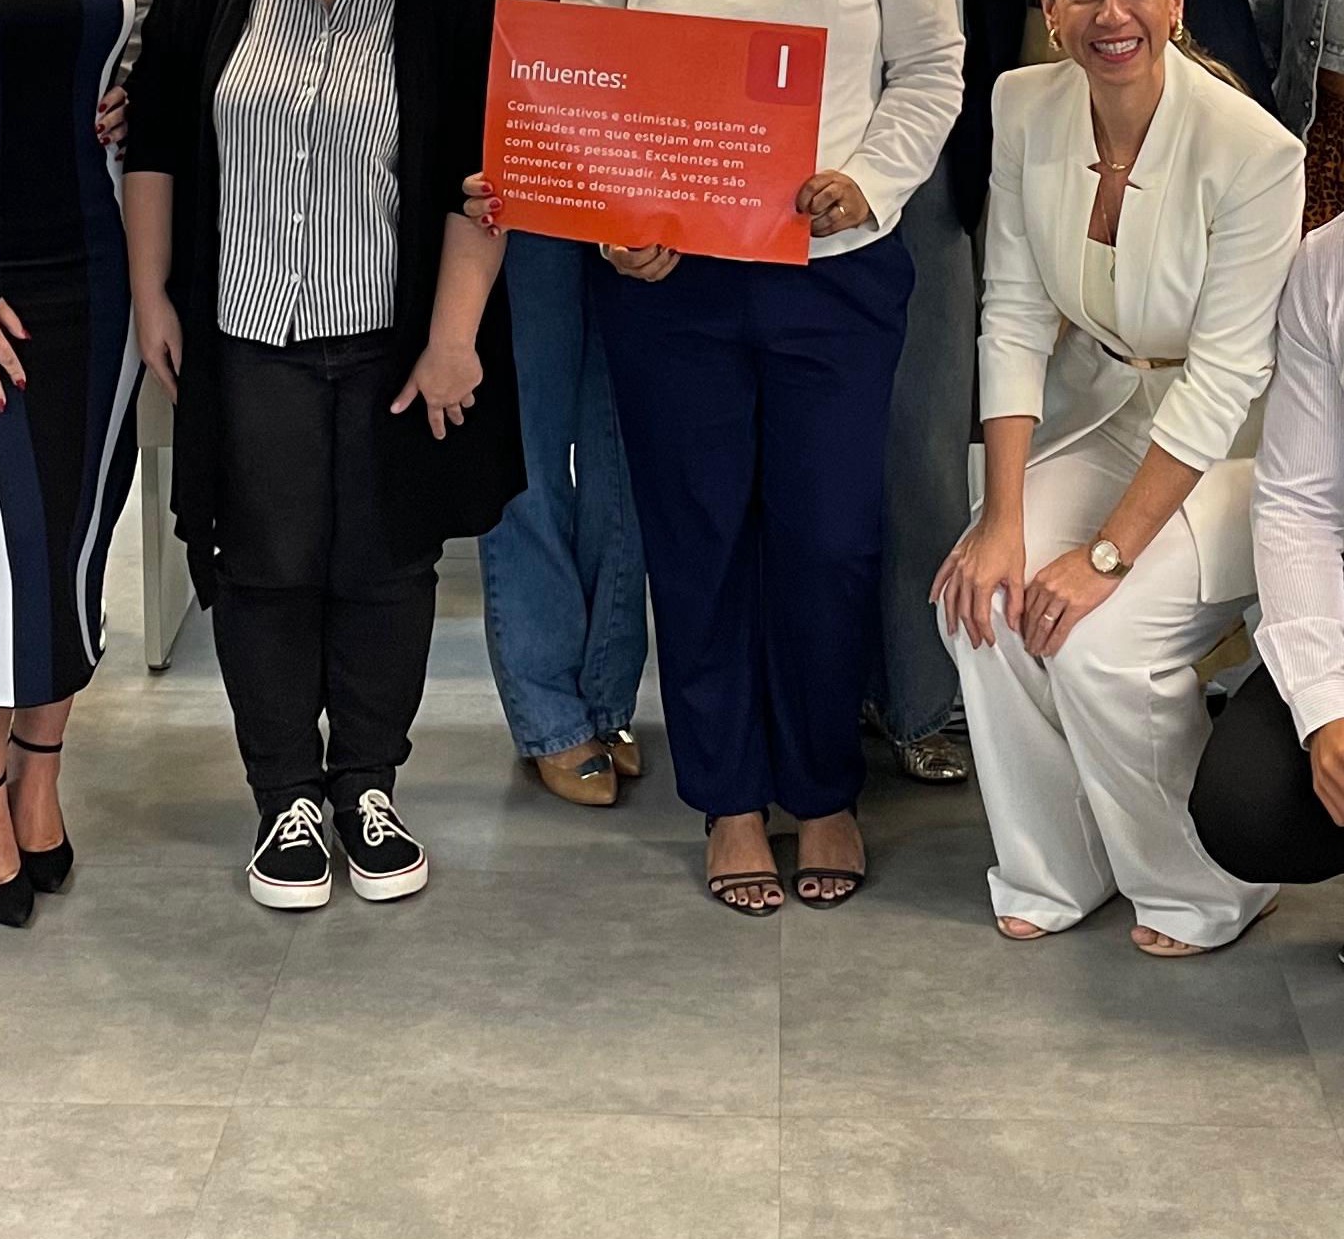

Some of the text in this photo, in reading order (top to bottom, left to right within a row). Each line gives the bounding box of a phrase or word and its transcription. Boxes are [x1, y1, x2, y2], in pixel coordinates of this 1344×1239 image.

[510, 59, 627, 90] Influentes:
[777, 44, 789, 89] I
[508, 101, 608, 120] Comunicativos
[612, 113, 619, 121] e
[694, 121, 745, 132] gostam
[750, 124, 766, 135] de
[506, 120, 770, 153] atividades em que estejam em contato
[505, 138, 533, 148] com
[537, 141, 580, 153] outras
[646, 150, 718, 166] Excelentes
[723, 160, 743, 169] em
[504, 155, 572, 170] convencer
[661, 168, 676, 181] Às
[682, 174, 718, 185] vezes
[723, 176, 745, 187] são
[503, 170, 573, 188] impulsivos
[704, 192, 736, 204] Foco
[740, 198, 761, 206] em
